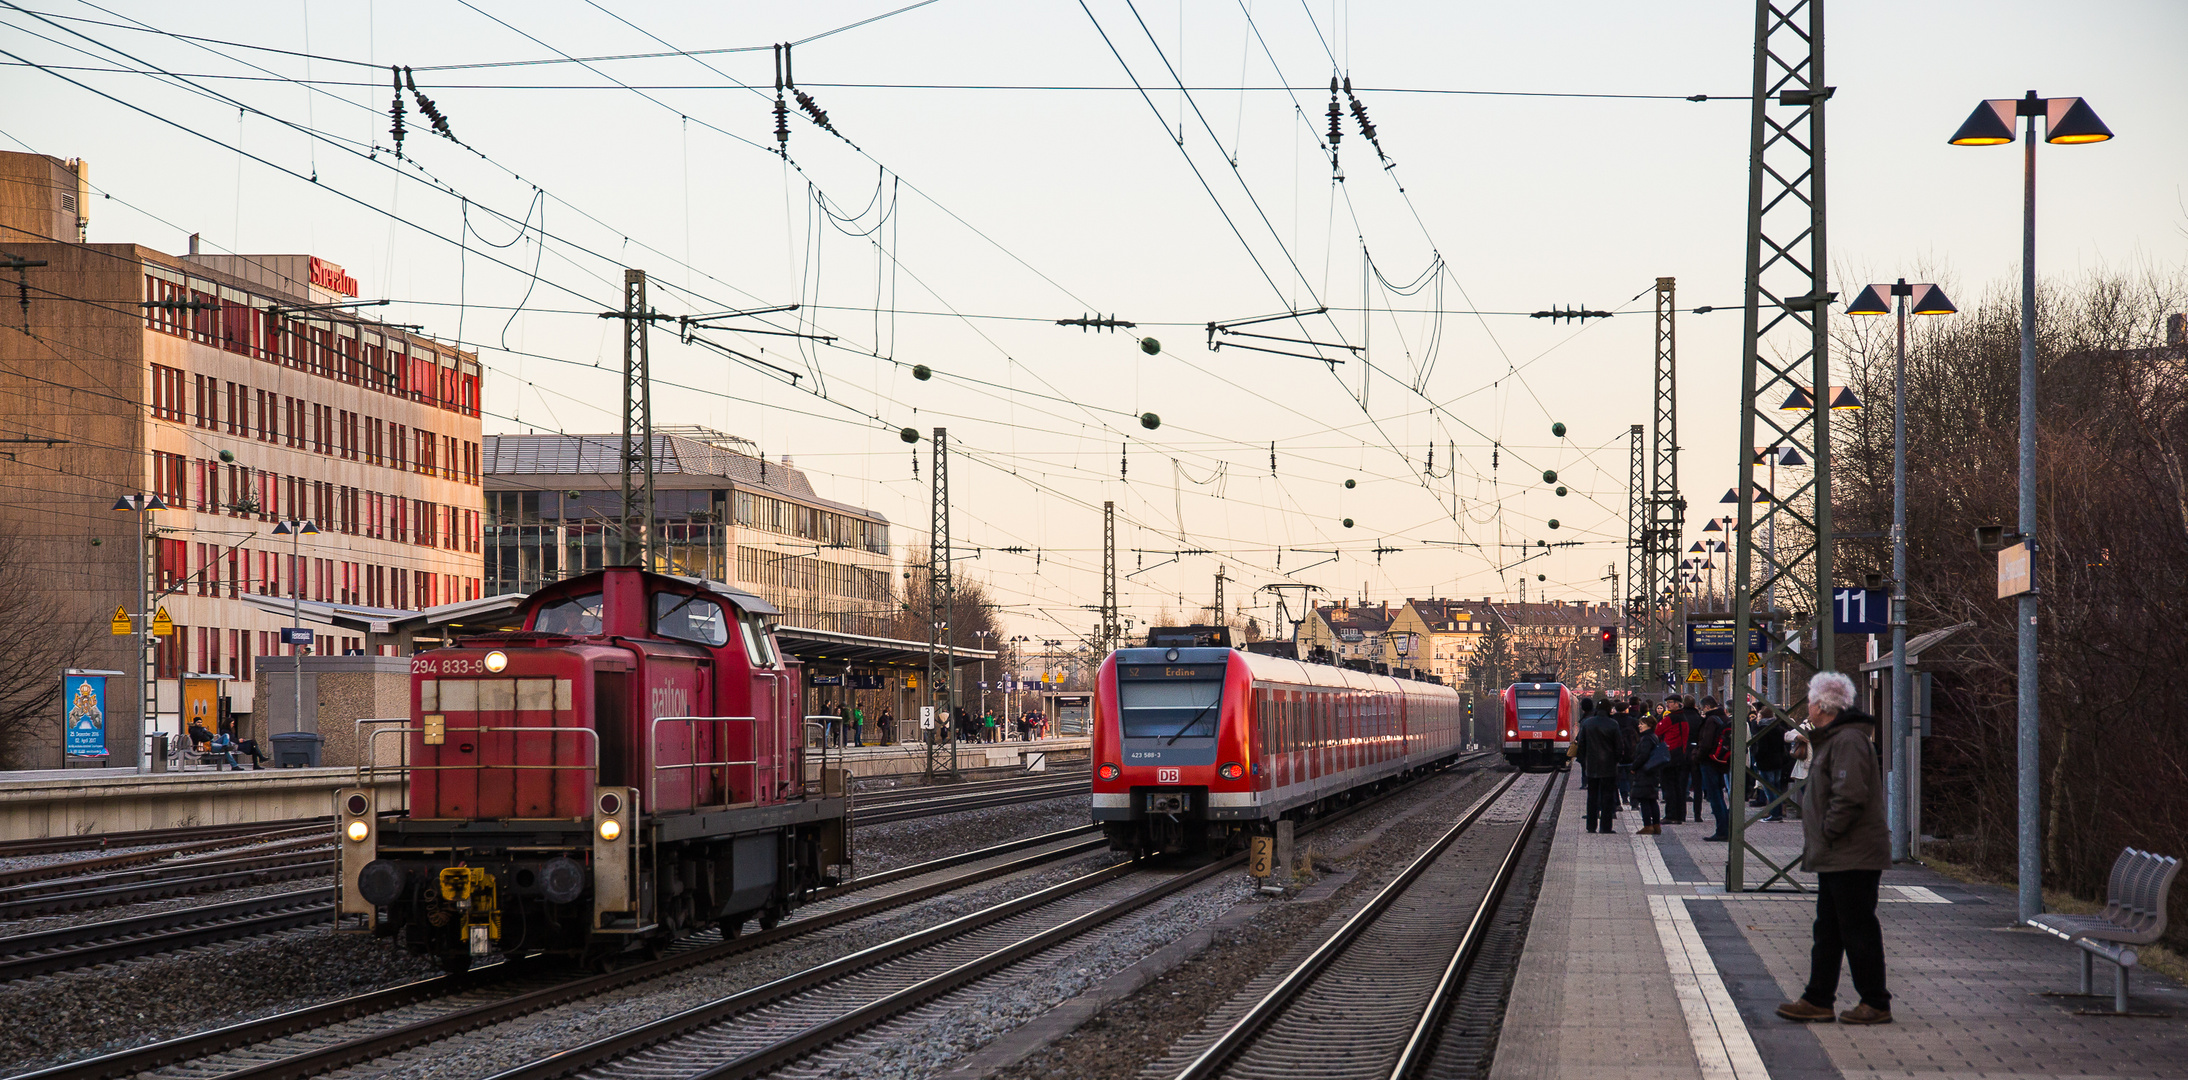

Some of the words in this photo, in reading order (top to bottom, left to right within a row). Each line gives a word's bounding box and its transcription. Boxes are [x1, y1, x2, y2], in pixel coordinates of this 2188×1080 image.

[310, 256, 359, 298] Sheraton
[1835, 590, 1866, 623] 11
[412, 660, 437, 674] 294
[442, 660, 484, 674] 833-9
[1129, 668, 1140, 677] S2
[925, 708, 930, 717] 3
[924, 718, 930, 727] 4
[1160, 770, 1178, 781] DB
[1257, 840, 1267, 855] 2
[1255, 857, 1266, 872] 6
